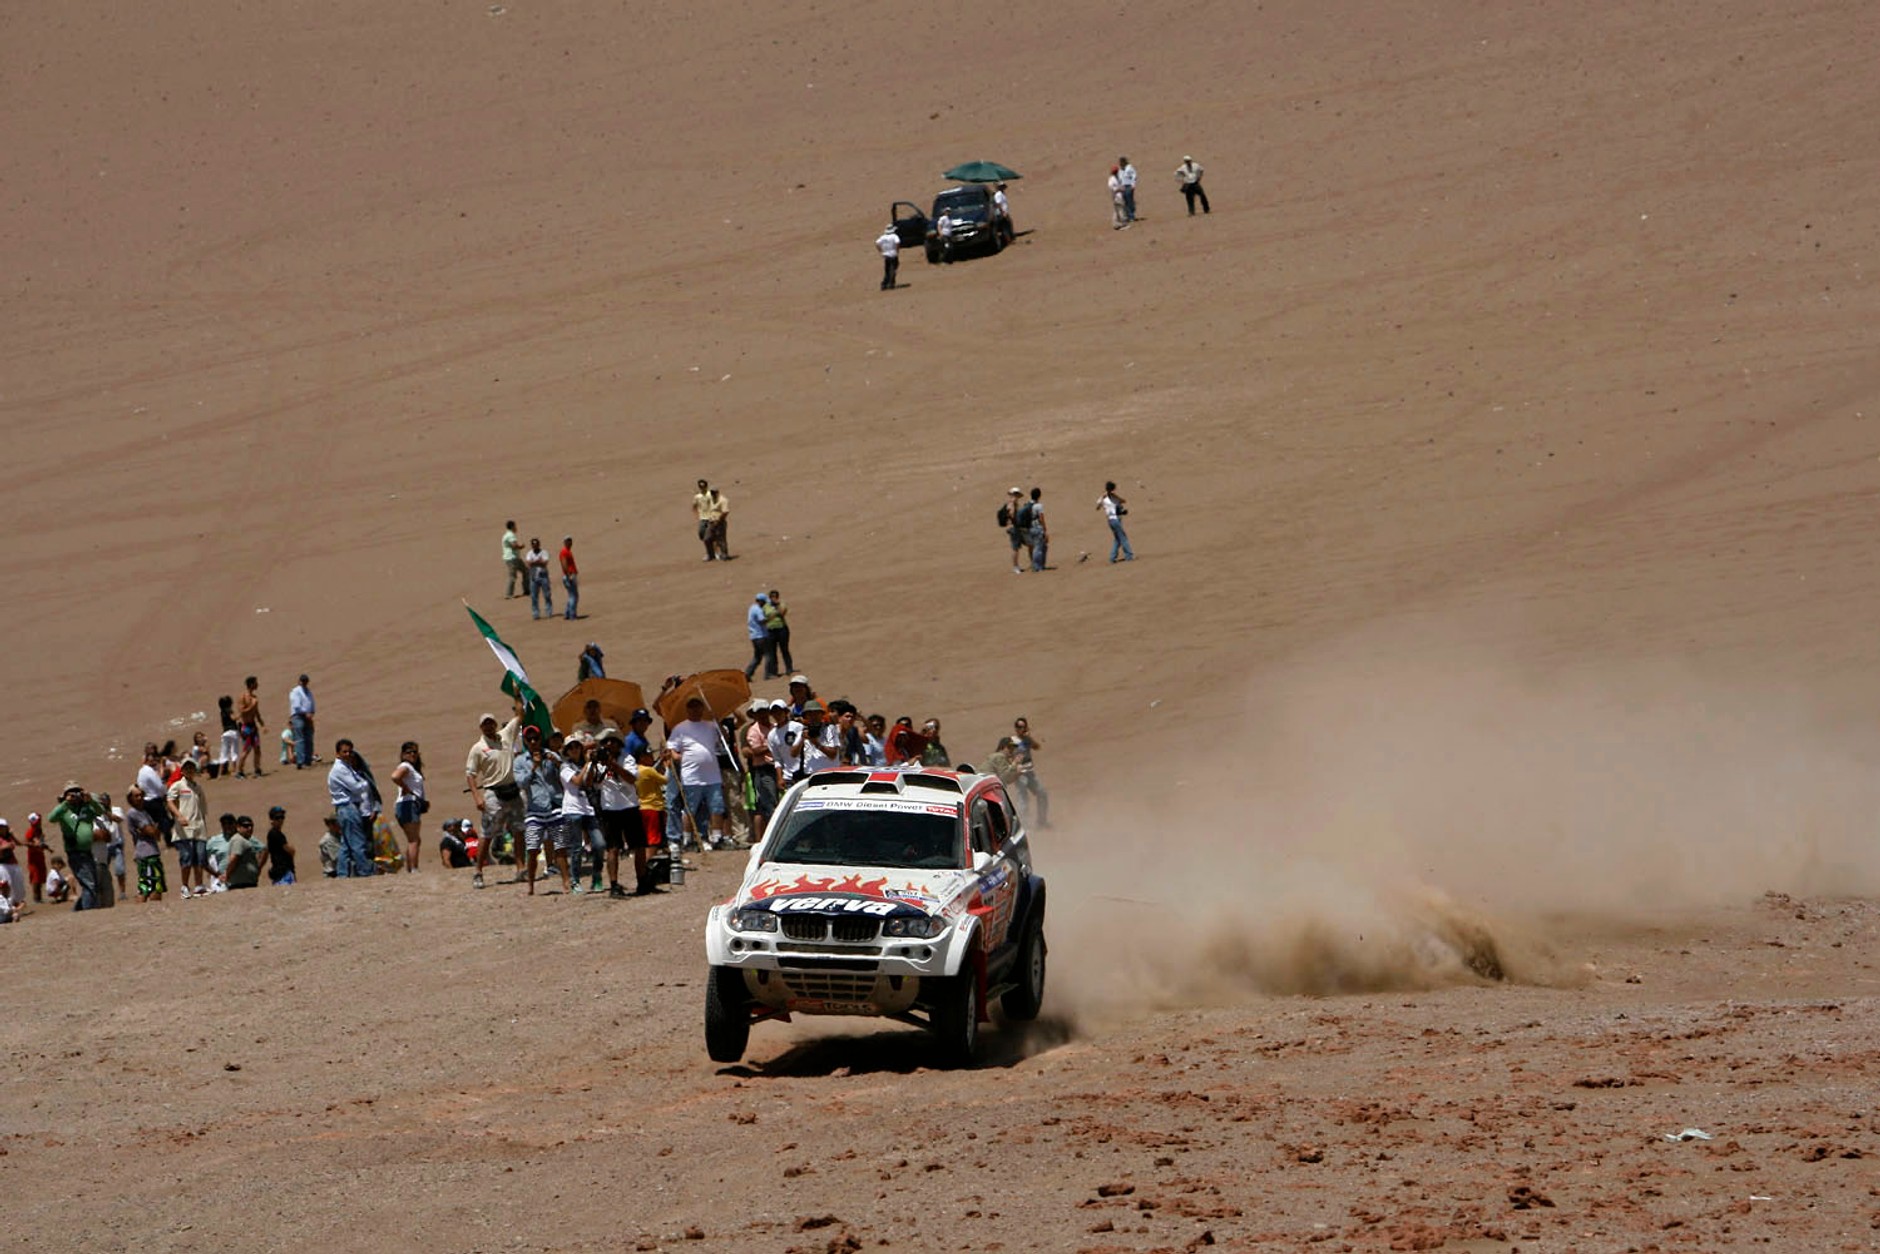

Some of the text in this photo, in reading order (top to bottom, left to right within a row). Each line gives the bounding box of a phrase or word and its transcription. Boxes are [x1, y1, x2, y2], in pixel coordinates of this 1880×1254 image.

[856, 801, 887, 809] Diesel
[890, 802, 923, 810] Power
[928, 806, 958, 814] TOTAL
[769, 896, 898, 916] verva
